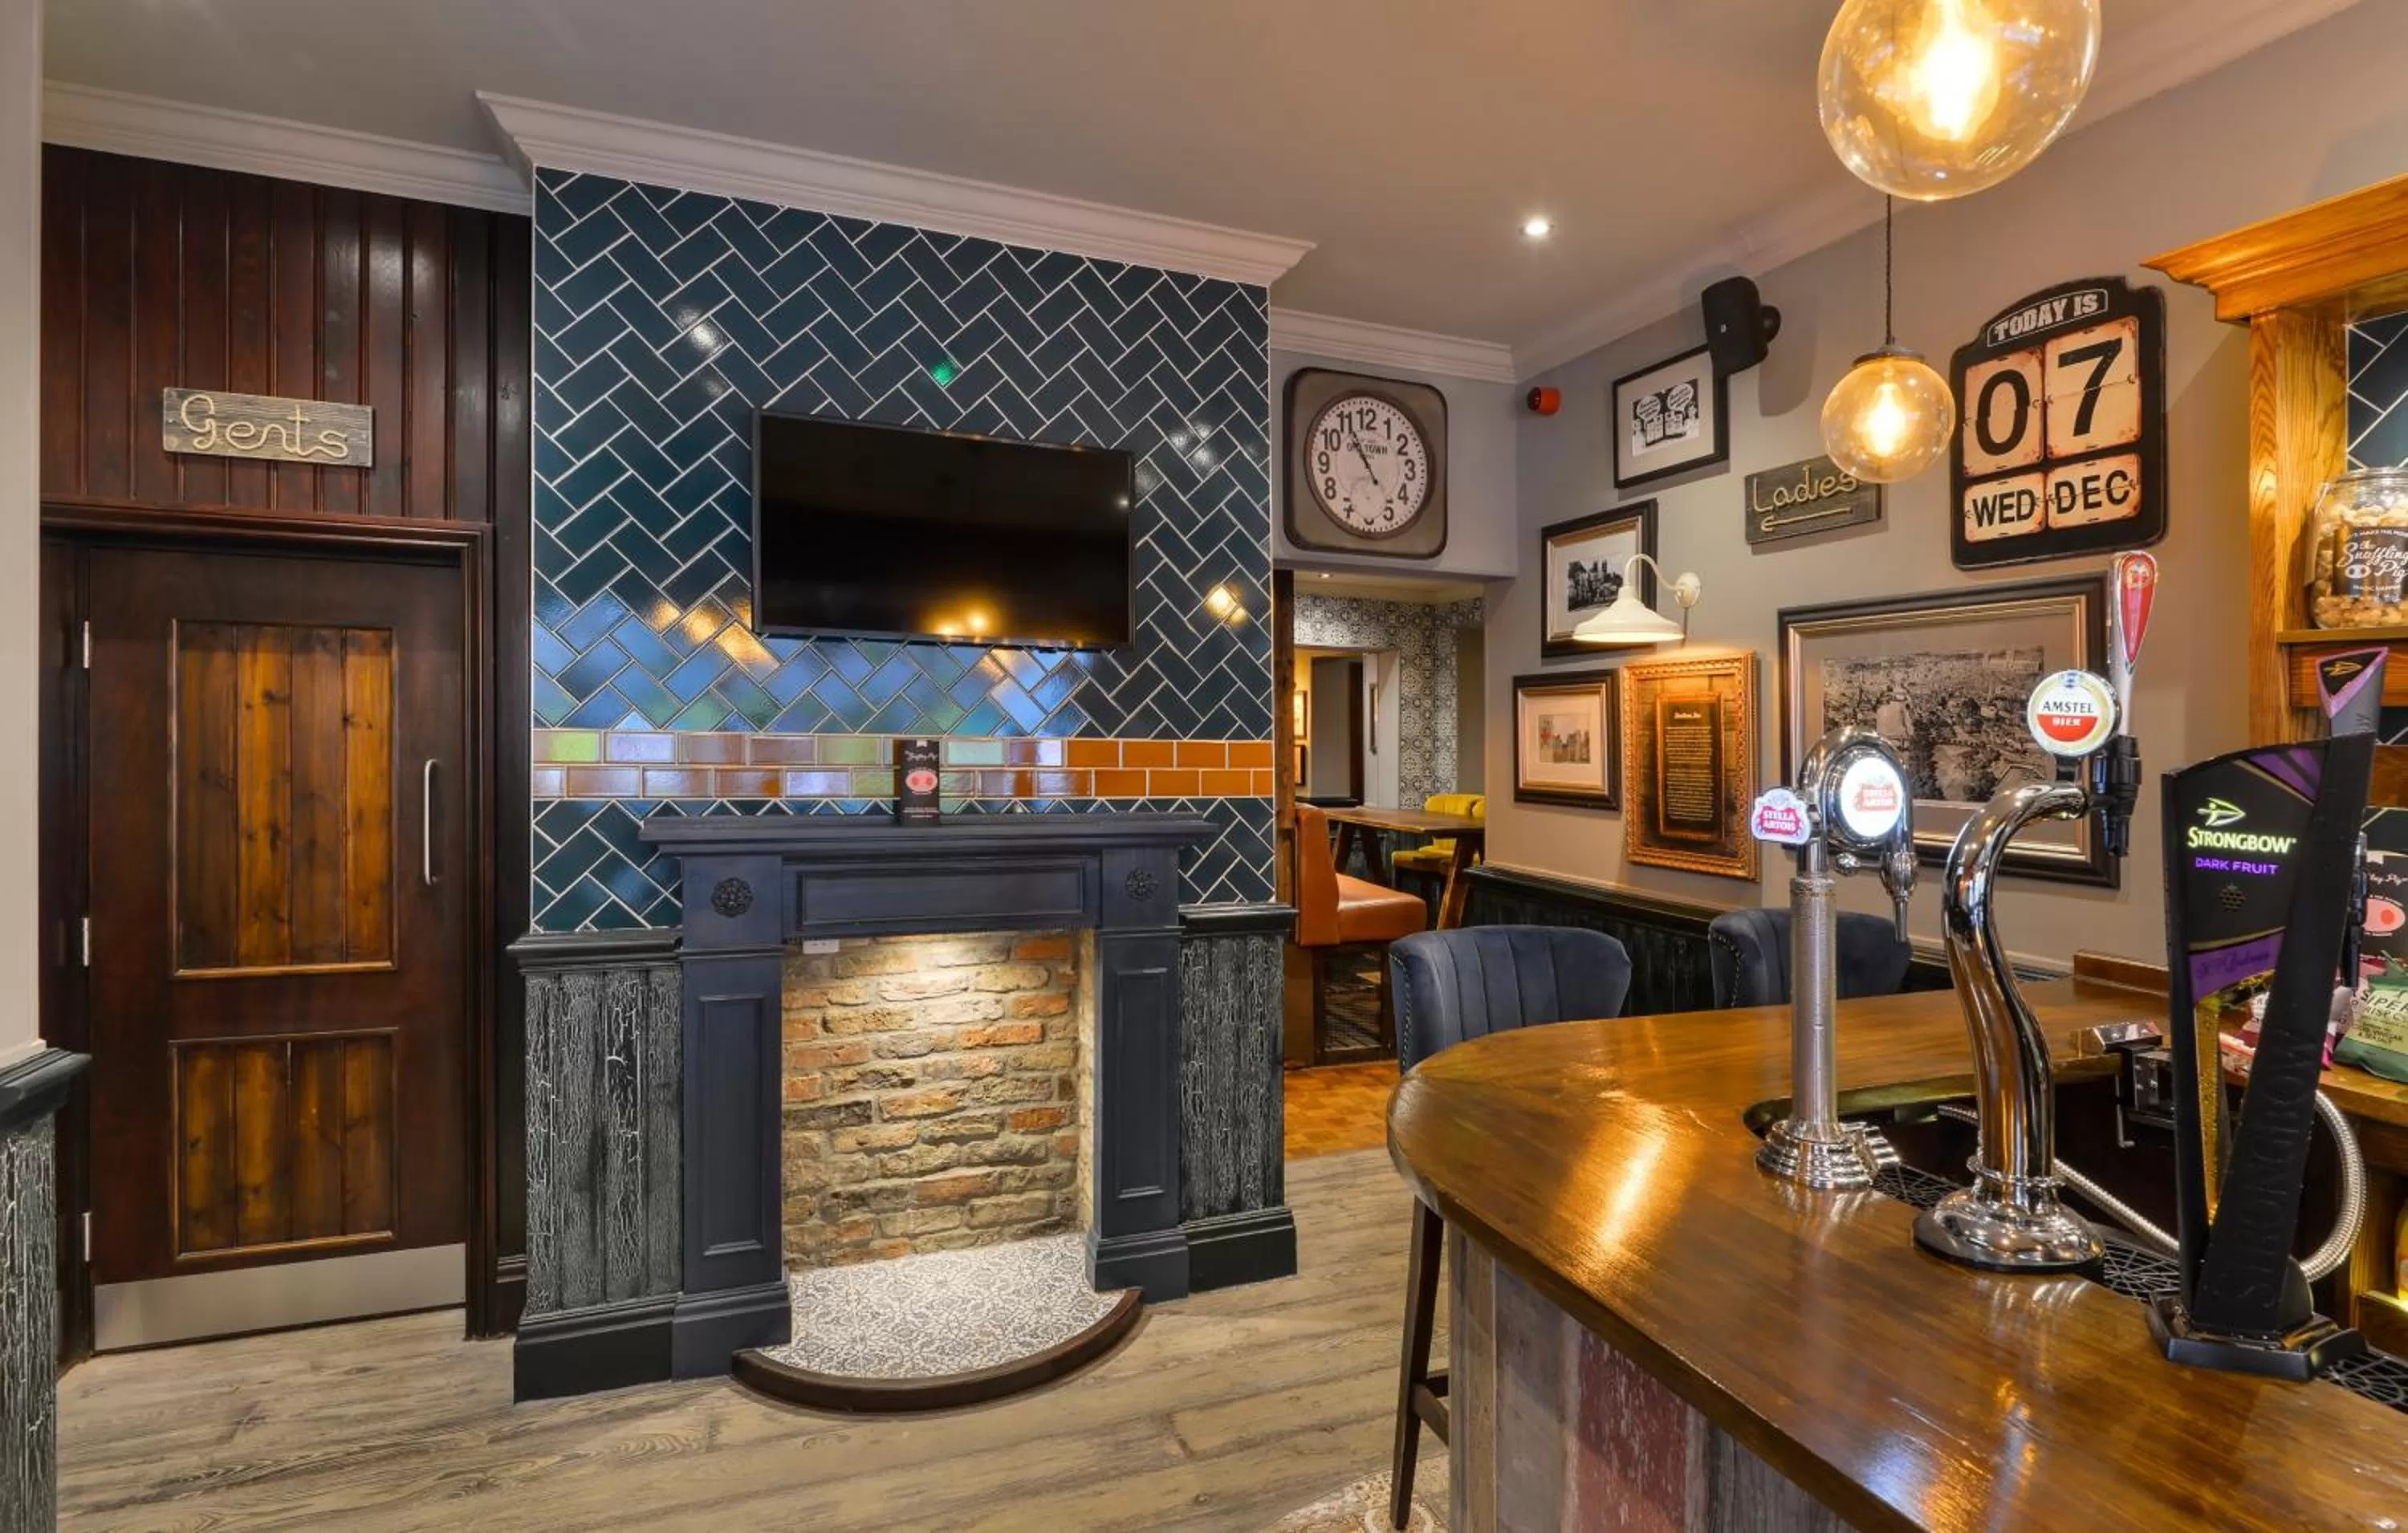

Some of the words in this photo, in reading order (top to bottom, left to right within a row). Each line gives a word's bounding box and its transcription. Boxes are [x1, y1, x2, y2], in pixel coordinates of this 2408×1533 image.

[1994, 298, 2067, 341] TODAY
[2073, 293, 2097, 316] IS
[180, 393, 349, 460] Gents
[1336, 410, 1352, 434] 11
[1356, 407, 1377, 431] 12
[1383, 417, 1391, 440] 1
[1321, 428, 1341, 451] 10
[1396, 433, 1409, 456] 2
[1317, 451, 1330, 474] 9
[1404, 459, 1416, 482] 3
[1324, 477, 1336, 500] 8
[1397, 482, 1409, 506] 4
[1752, 463, 1859, 513] Ladies
[1971, 488, 2036, 528] WED
[2054, 469, 2130, 514] DEC
[2373, 559, 2408, 584] Pig
[2041, 701, 2094, 714] AMSTEL
[2052, 717, 2081, 727] BIER
[1763, 809, 1795, 820] STELLA
[2187, 826, 2294, 854] STRONGBOW
[2194, 856, 2230, 871] DARK
[2231, 860, 2279, 875] FRUIT
